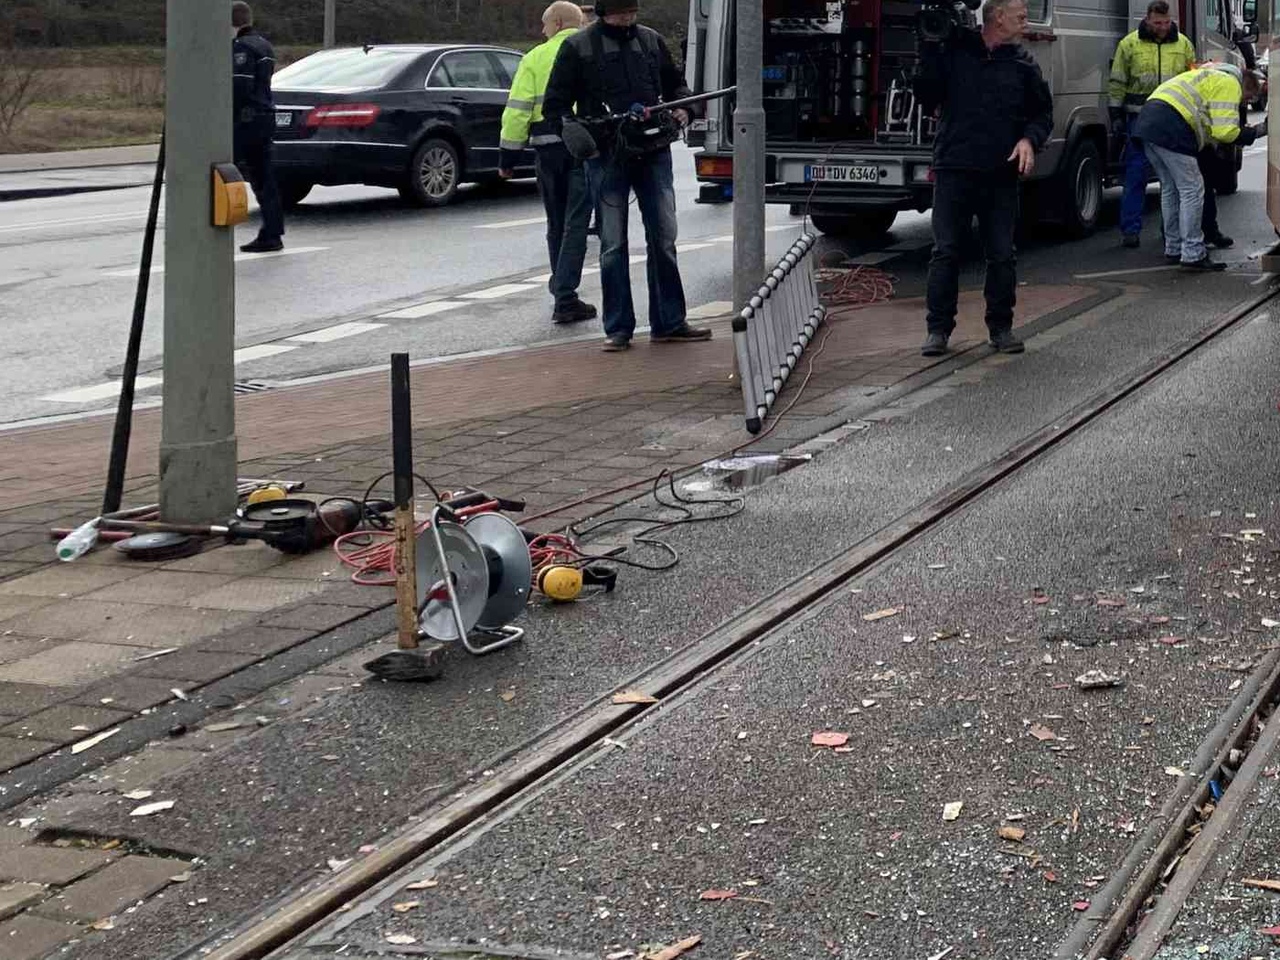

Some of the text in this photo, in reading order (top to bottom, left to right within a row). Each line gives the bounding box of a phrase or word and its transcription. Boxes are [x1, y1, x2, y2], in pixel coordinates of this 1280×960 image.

[812, 166, 876, 180] DU DV 6346
